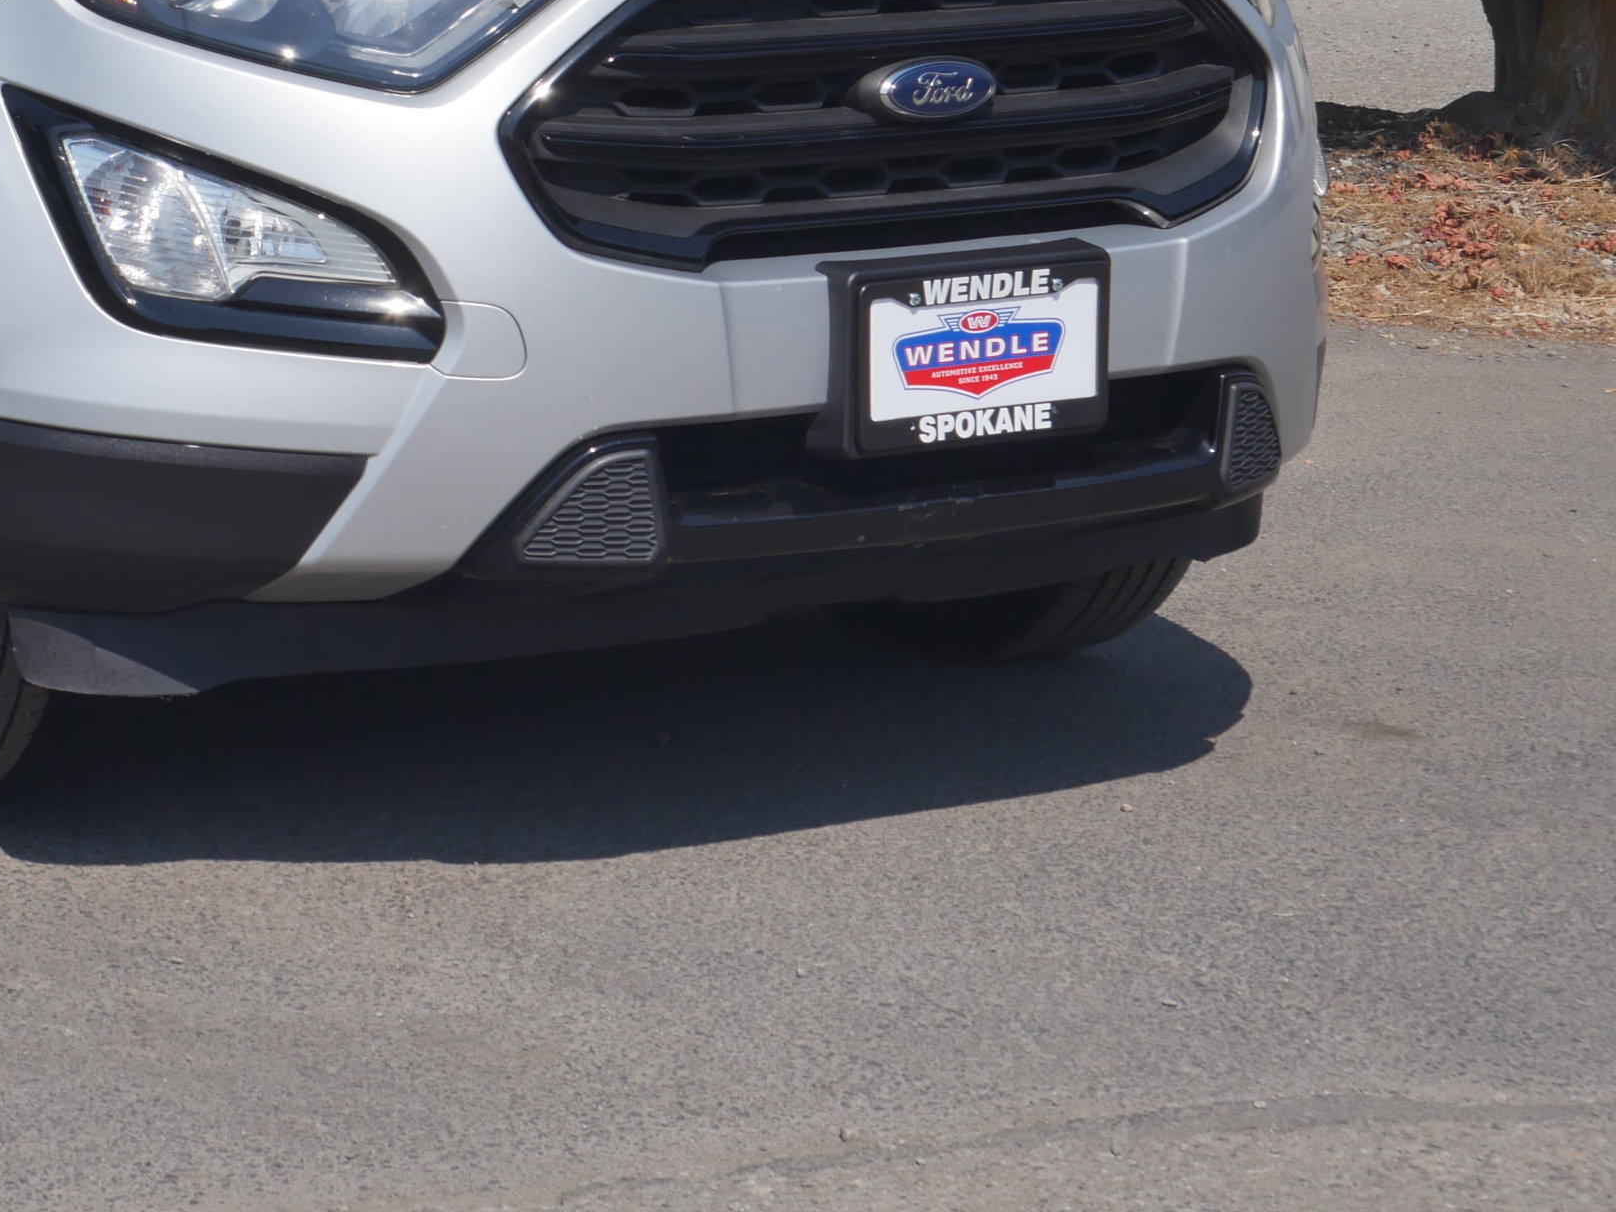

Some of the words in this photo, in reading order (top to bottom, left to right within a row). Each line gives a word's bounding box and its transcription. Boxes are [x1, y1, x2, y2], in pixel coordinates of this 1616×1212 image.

[912, 71, 974, 106] Ford
[923, 268, 1051, 305] WENDLE
[904, 332, 1050, 366] WENDLE
[931, 367, 977, 379] AUTOMOTIVE
[978, 361, 1024, 373] EXCELLENCE
[958, 376, 980, 385] SINCE
[981, 373, 999, 382] 1943
[919, 403, 1052, 443] SPOKANE
